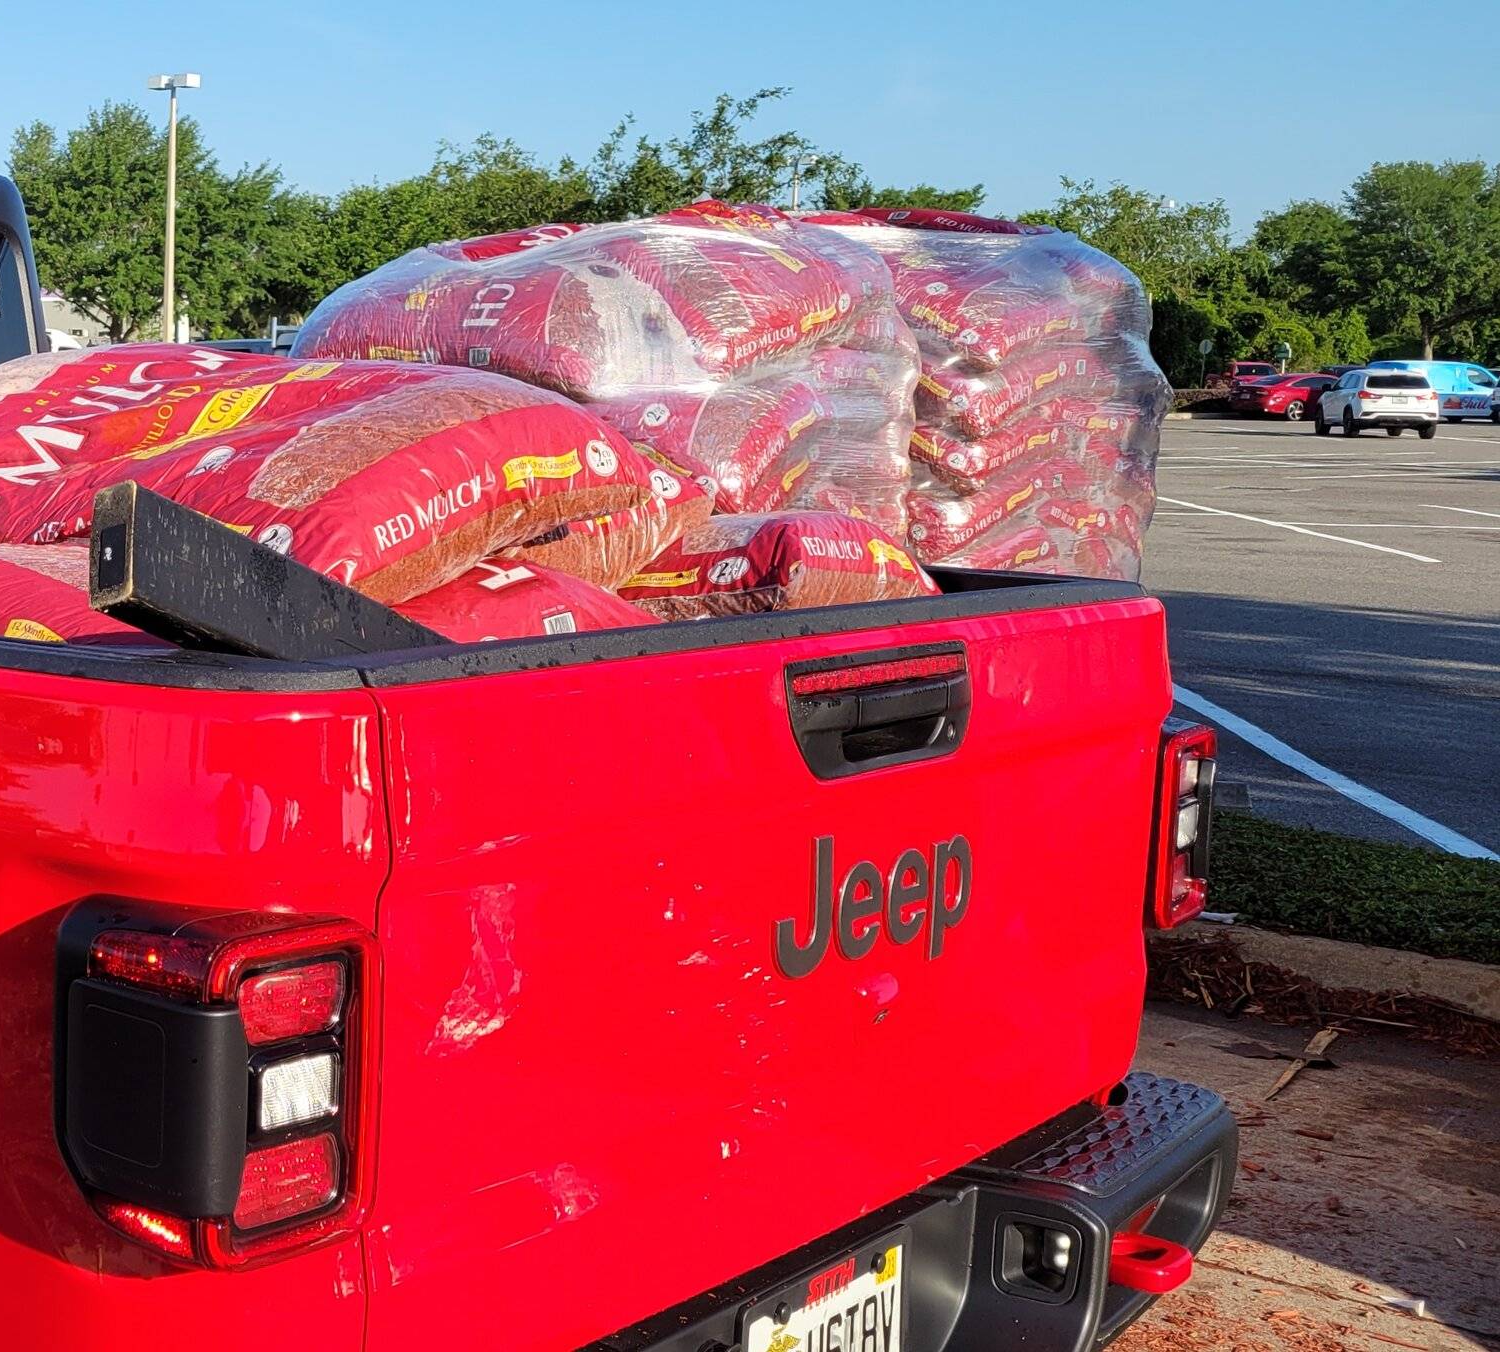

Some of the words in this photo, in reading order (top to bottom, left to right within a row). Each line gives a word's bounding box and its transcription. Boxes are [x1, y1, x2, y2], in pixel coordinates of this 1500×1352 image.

[646, 410, 661, 422] 2
[654, 475, 669, 492] 2
[374, 514, 414, 551] RED
[415, 474, 484, 531] MULCH
[953, 528, 974, 545] RED
[717, 562, 728, 578] 2
[771, 833, 972, 980] Jeep
